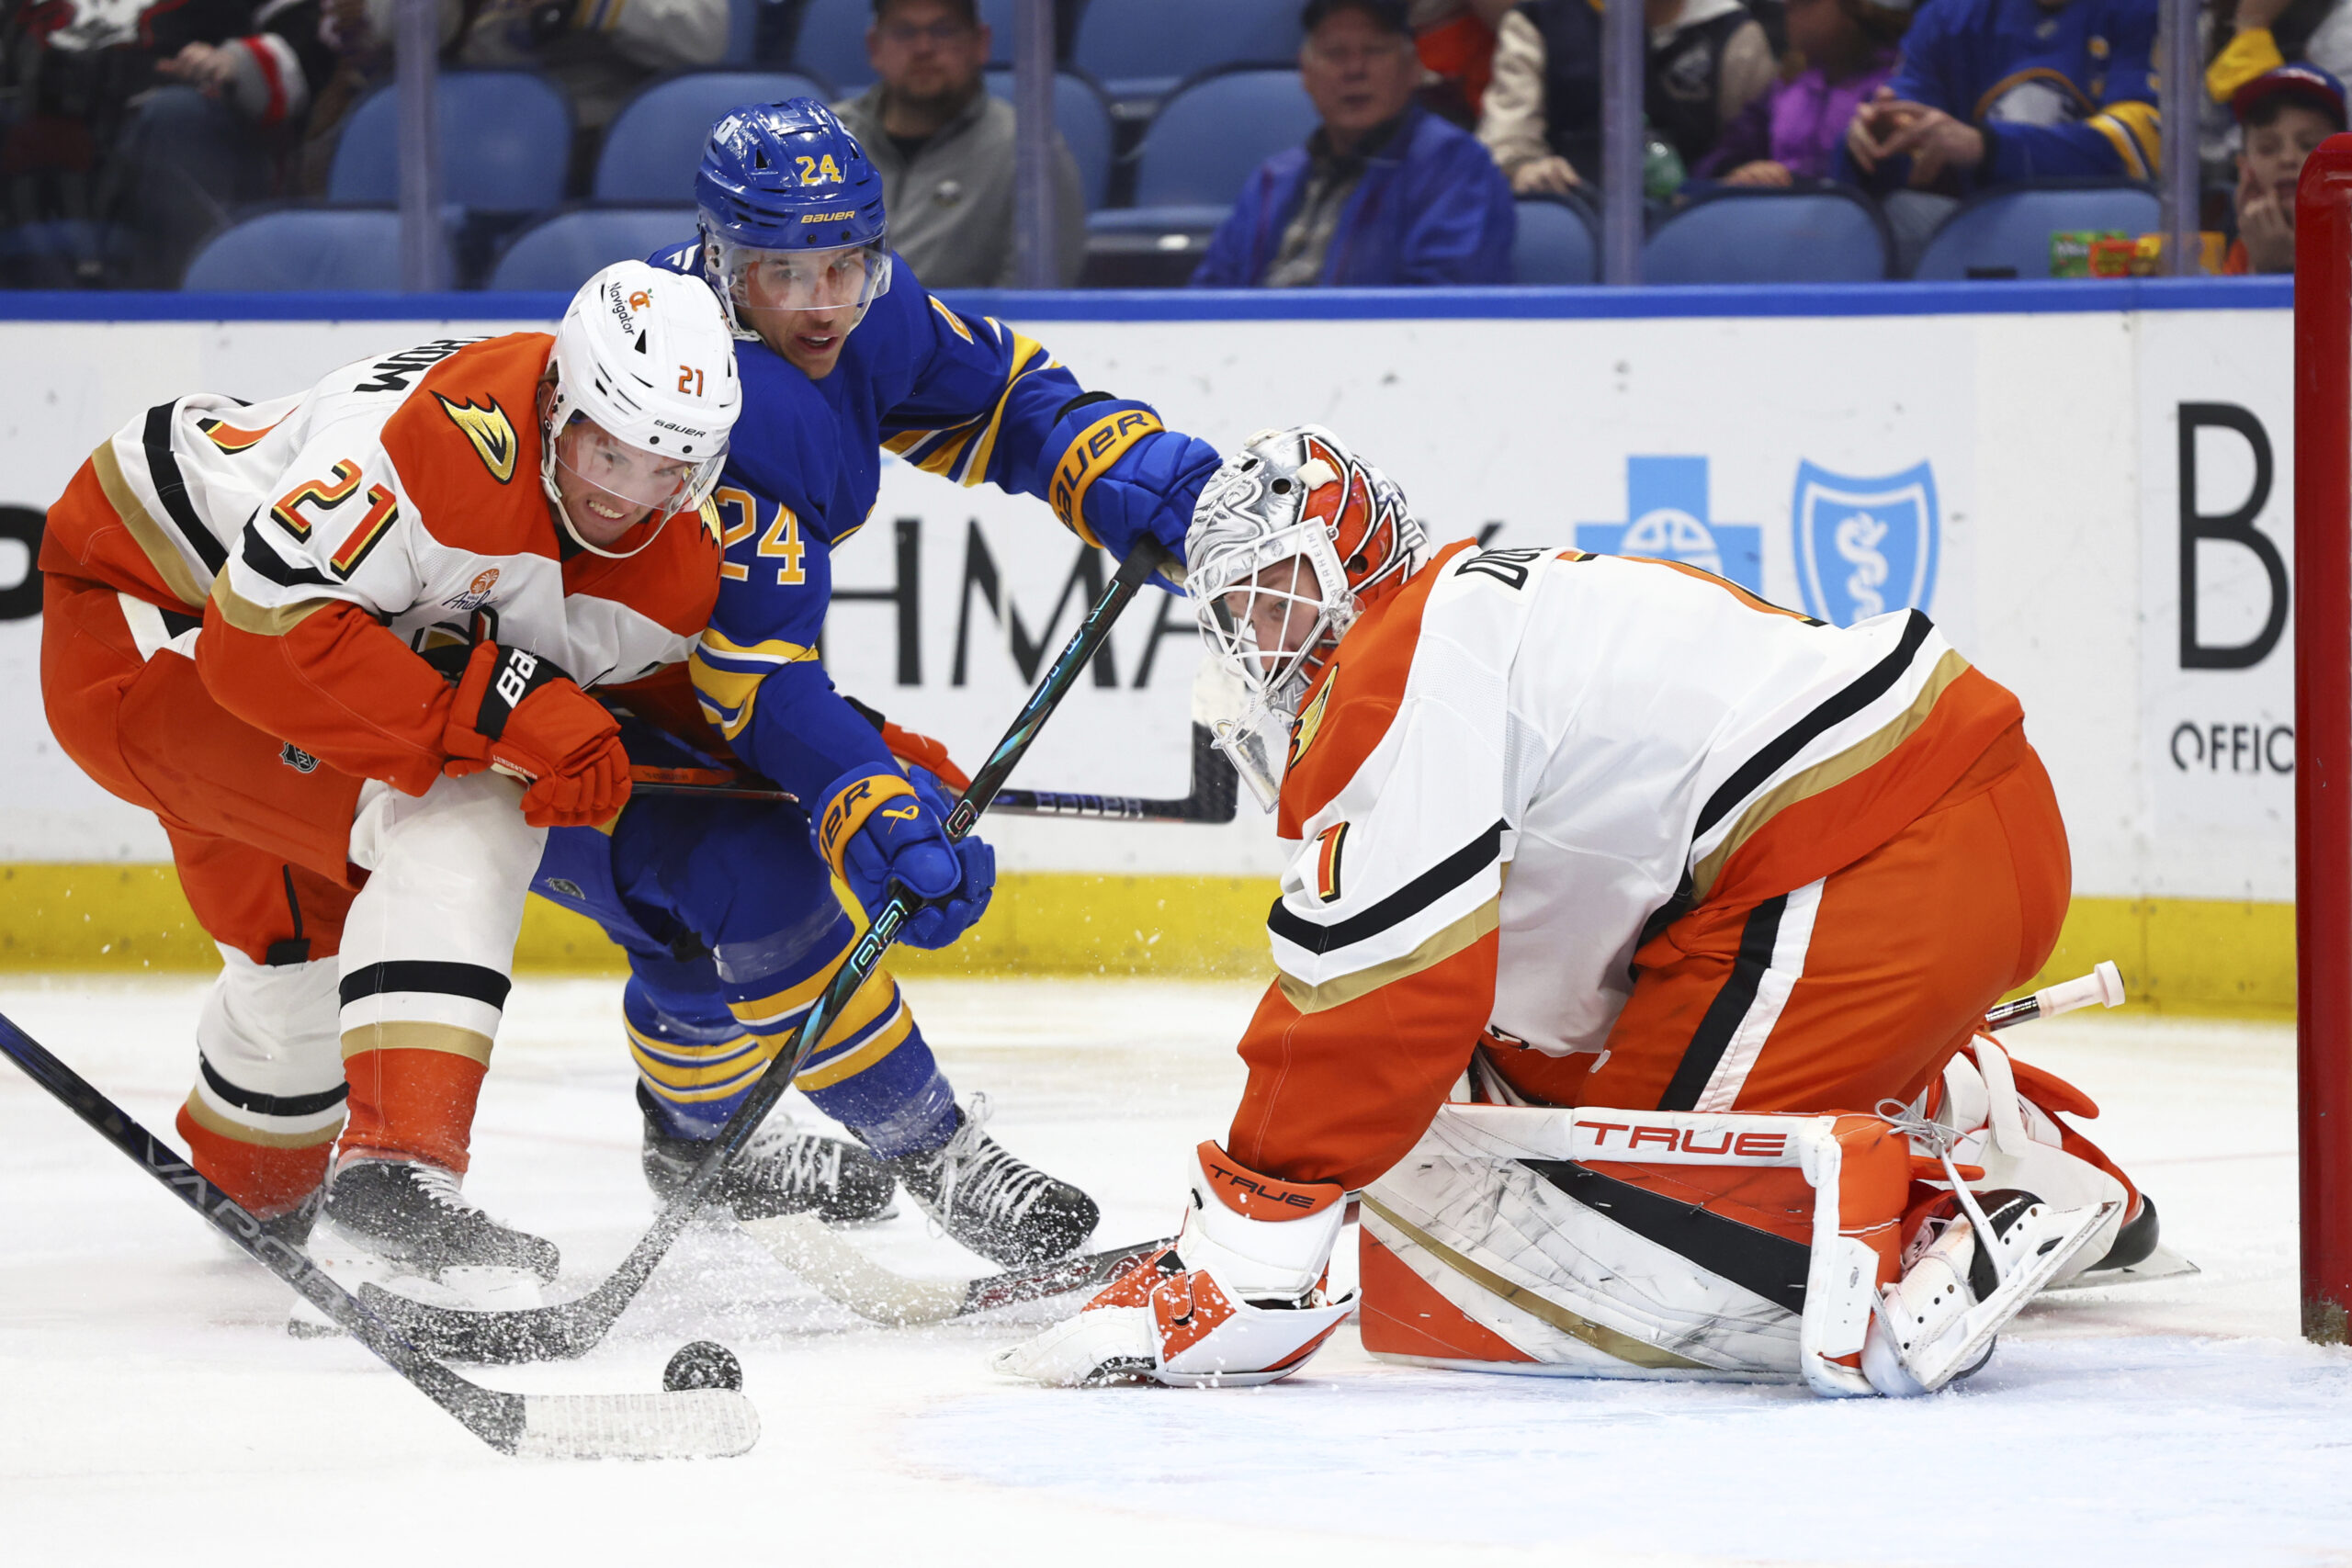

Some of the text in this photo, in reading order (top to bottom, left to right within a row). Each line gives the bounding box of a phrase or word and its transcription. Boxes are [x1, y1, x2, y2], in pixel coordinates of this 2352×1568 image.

[796, 154, 842, 184] 24
[801, 211, 855, 224] BAUER
[607, 282, 635, 335] Navigator
[678, 365, 704, 397] 21
[653, 419, 707, 438] BAUER
[270, 458, 400, 581] 21
[716, 485, 806, 585] 24
[1574, 1120, 1787, 1157] TRUE
[1209, 1163, 1316, 1209] TRUE
